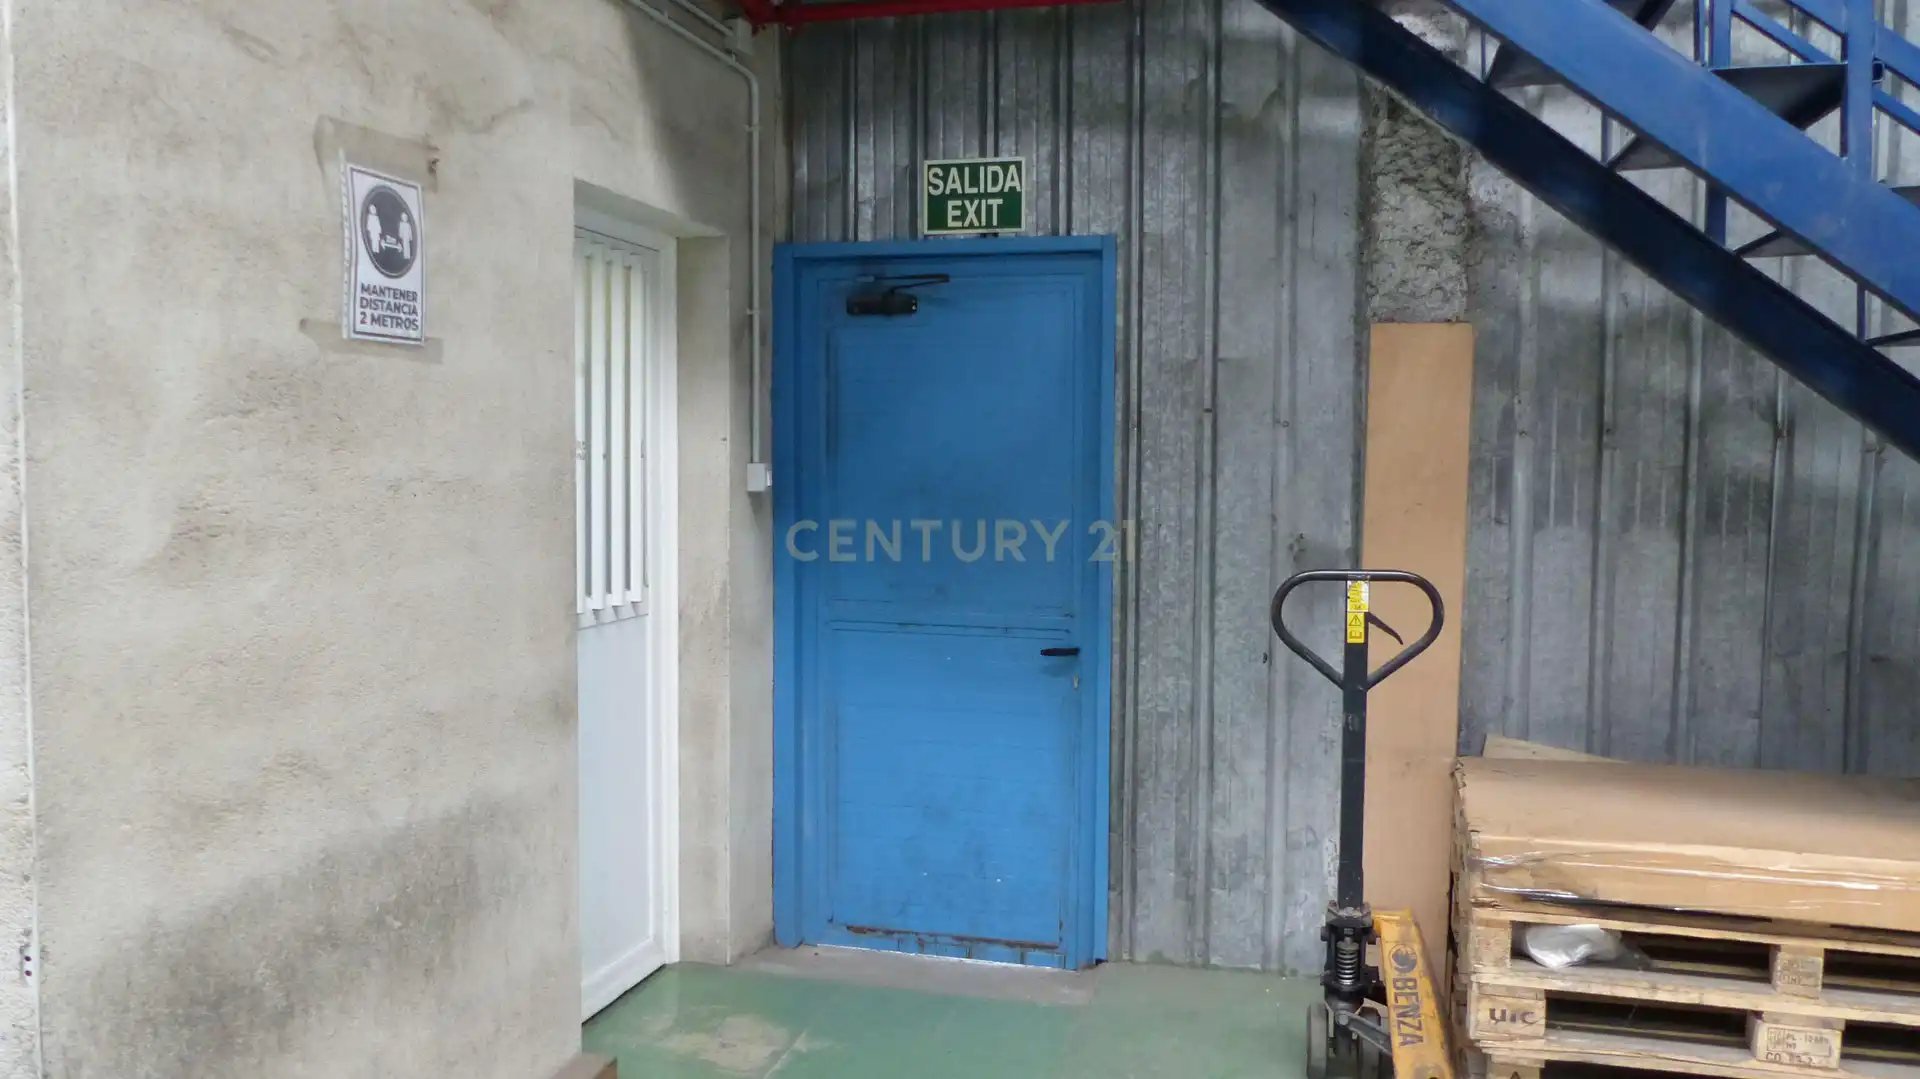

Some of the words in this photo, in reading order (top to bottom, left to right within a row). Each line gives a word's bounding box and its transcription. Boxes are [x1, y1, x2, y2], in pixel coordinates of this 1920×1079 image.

[928, 164, 1022, 196] SALIDA
[947, 198, 1004, 228] EXIT
[360, 282, 418, 302] MANTENER
[359, 296, 419, 317] DISTANCIA
[360, 311, 369, 325] 2
[370, 312, 420, 331] METROS
[1392, 977, 1425, 1047] BENZA
